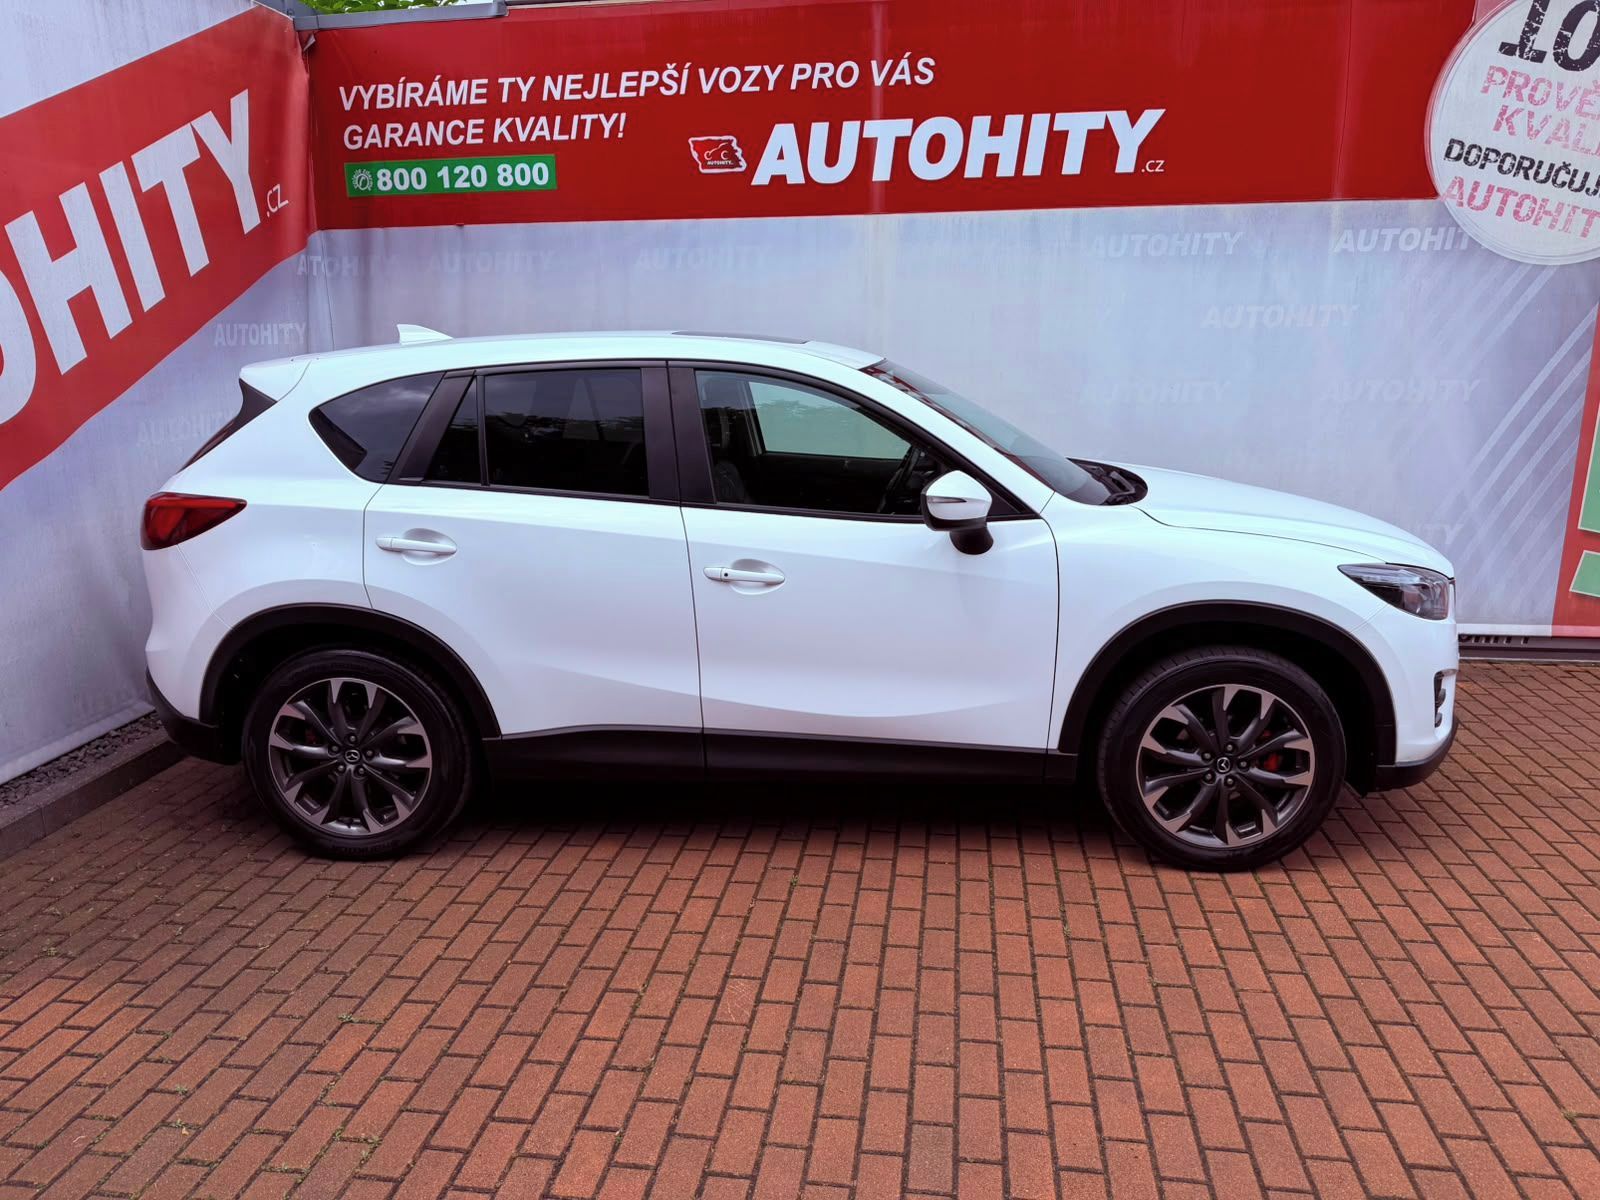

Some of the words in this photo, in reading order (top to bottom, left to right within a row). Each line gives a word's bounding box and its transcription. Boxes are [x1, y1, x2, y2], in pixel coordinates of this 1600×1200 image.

[339, 75, 488, 111] VYBÍRÁME
[498, 76, 536, 103] TY
[542, 62, 692, 101] NEJLEPŠÍ
[698, 64, 784, 94] VOZY
[790, 61, 860, 91] PRO
[870, 52, 936, 87] VÁS
[343, 119, 485, 150] GARANCE
[493, 112, 627, 143] KVALITY!
[376, 167, 427, 191] 800
[437, 165, 487, 189] 120
[496, 162, 549, 187] 800
[213, 322, 306, 346] AUTOHITY
